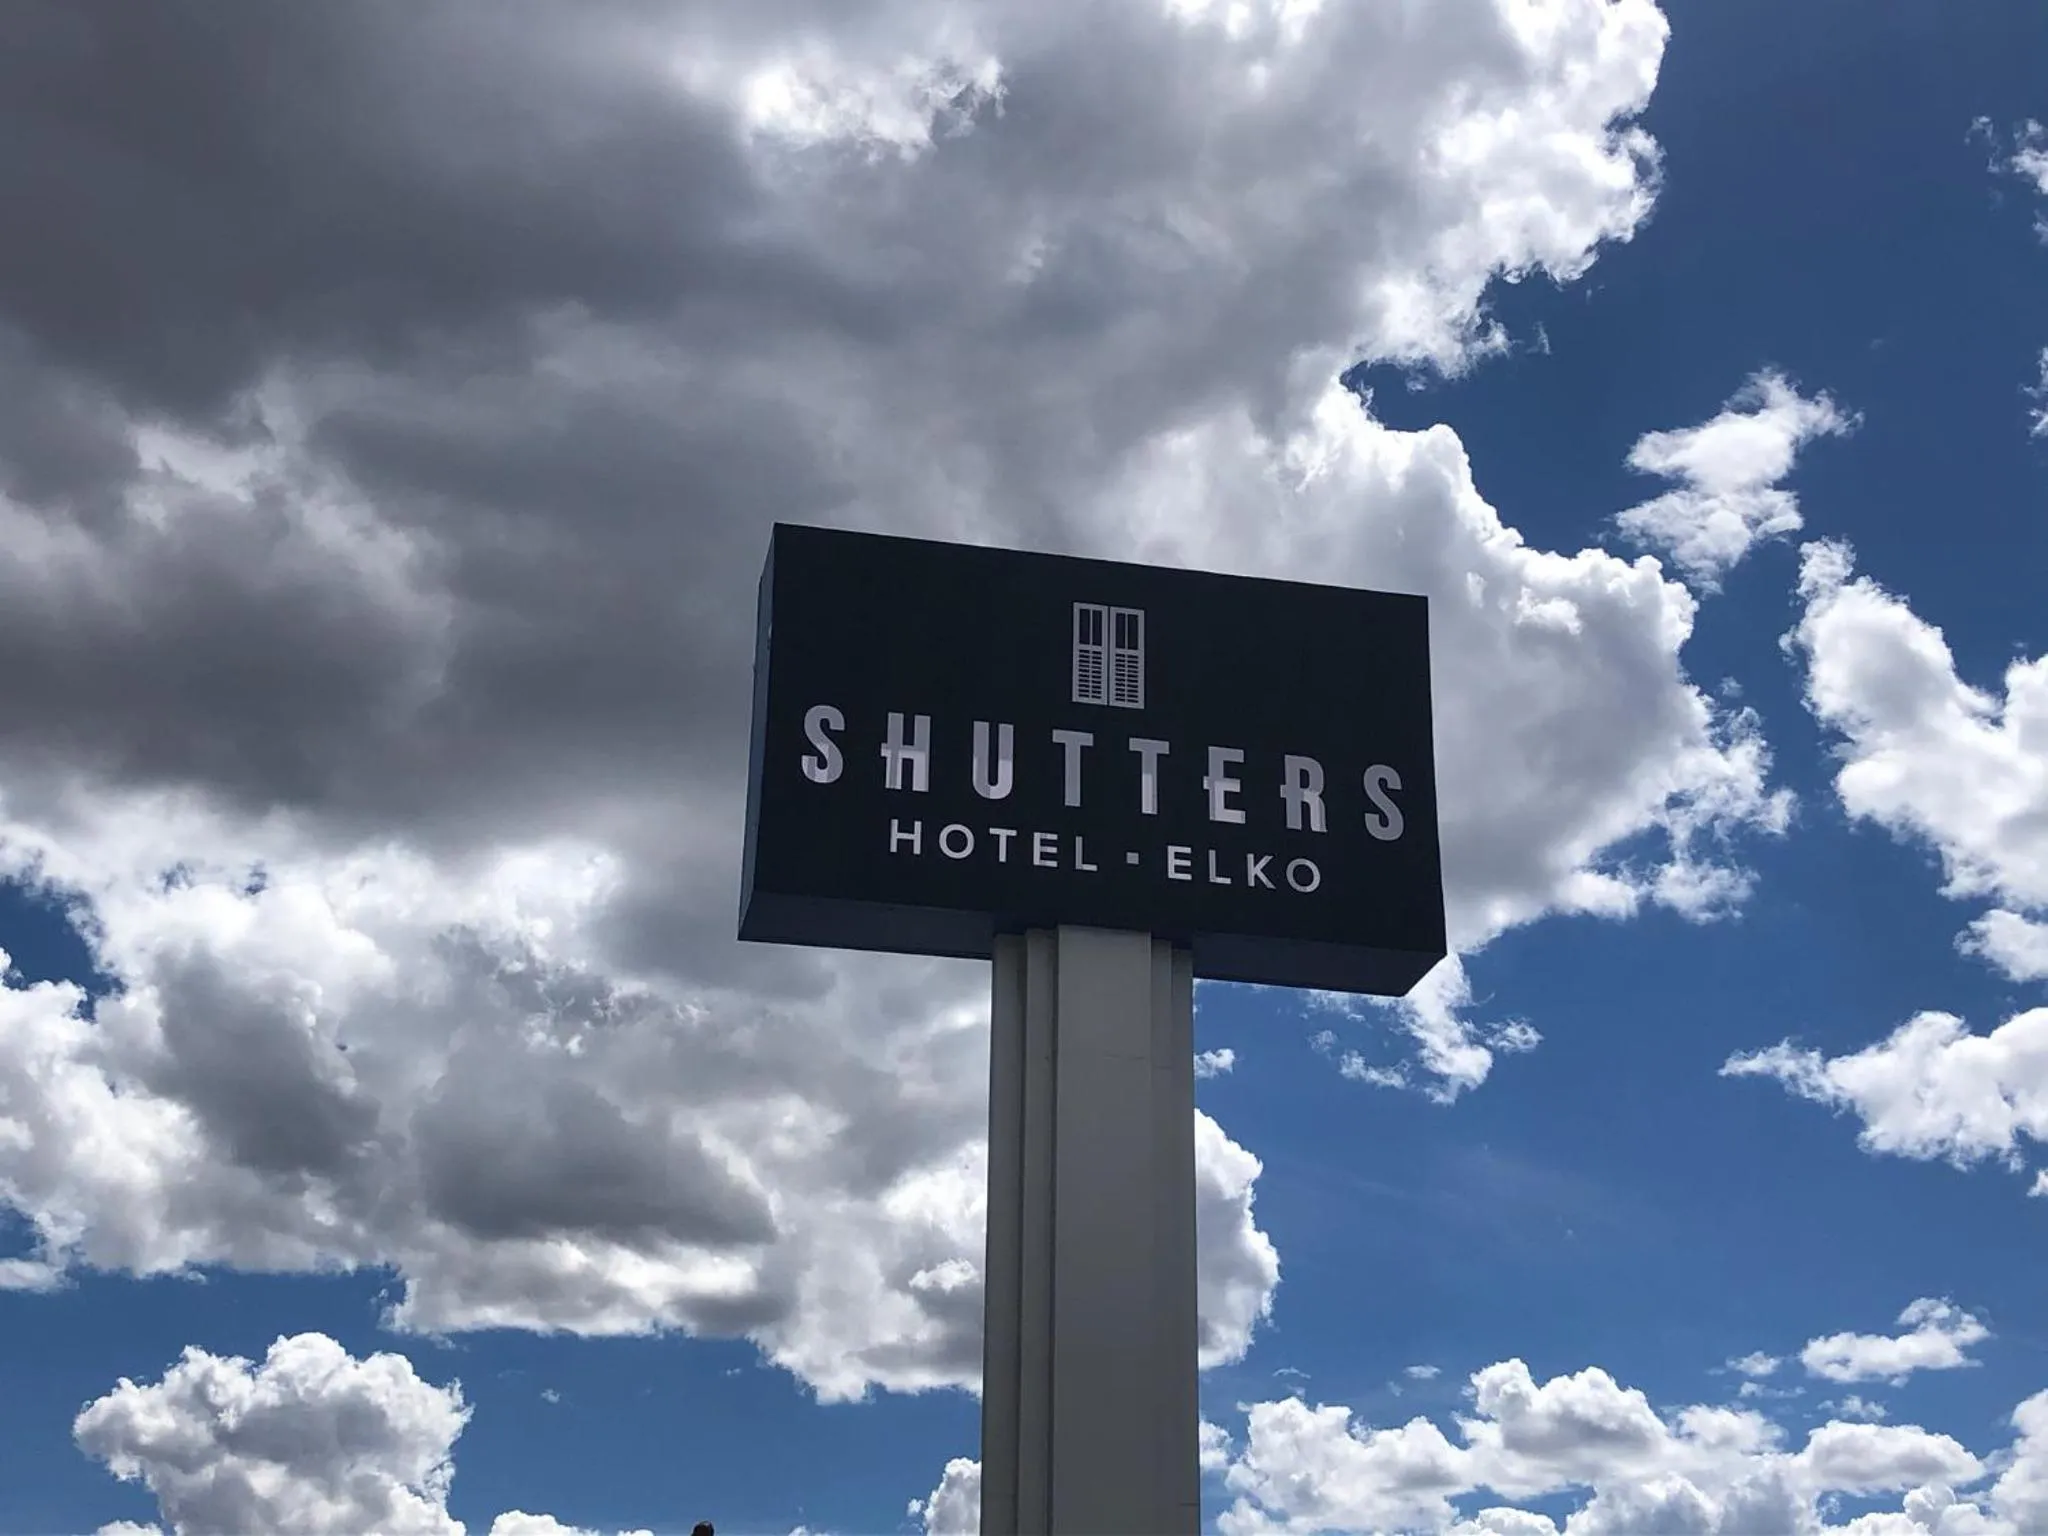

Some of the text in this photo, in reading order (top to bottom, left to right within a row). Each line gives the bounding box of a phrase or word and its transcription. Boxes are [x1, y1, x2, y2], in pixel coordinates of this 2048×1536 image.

[801, 705, 1404, 841] SHUTTERS
[889, 818, 1321, 893] HOTEL ELKO
